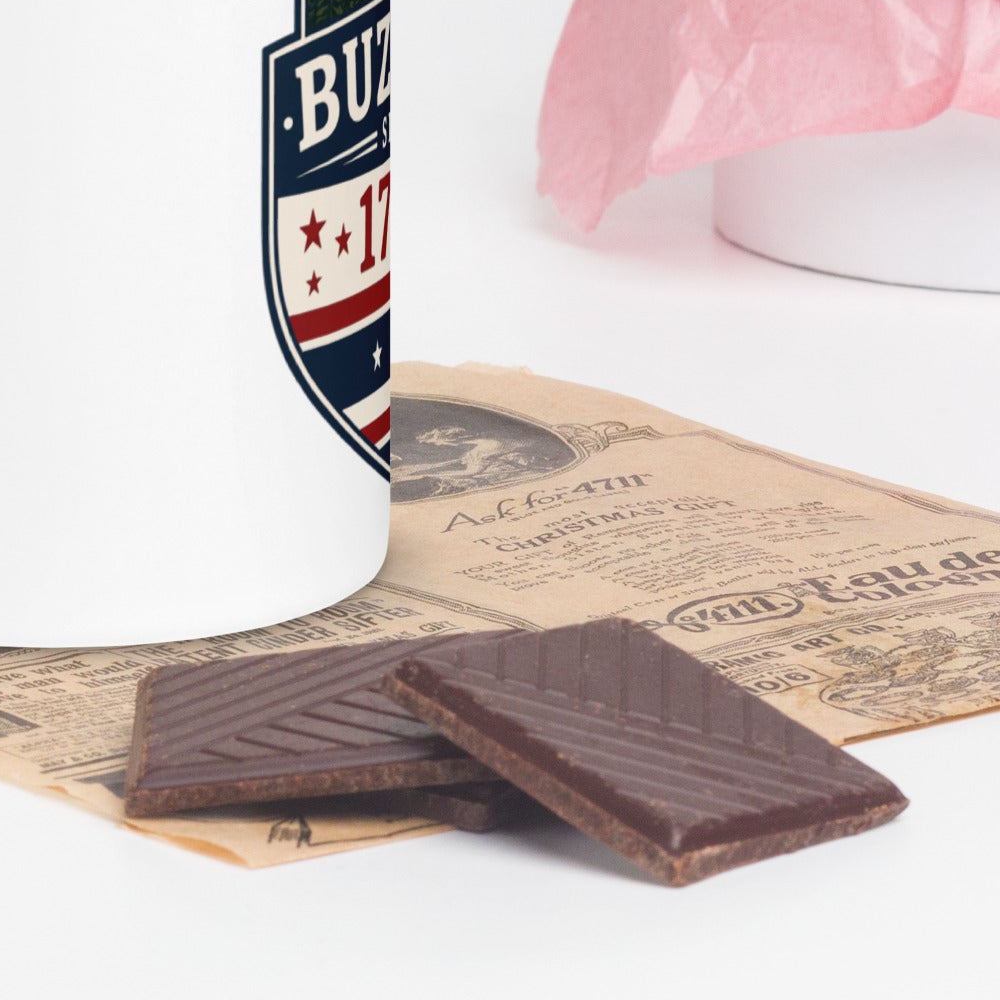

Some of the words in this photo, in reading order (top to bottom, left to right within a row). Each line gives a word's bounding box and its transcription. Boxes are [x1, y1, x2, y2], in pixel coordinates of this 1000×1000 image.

[441, 498, 515, 533] Ask
[523, 490, 568, 510] for
[472, 536, 520, 545] The
[543, 510, 588, 528] most
[496, 507, 665, 552] CHRISTMAS
[673, 500, 737, 512] GIFT
[453, 561, 508, 575] YOUR
[801, 560, 935, 593] Eau
[939, 550, 1000, 571] de
[246, 625, 338, 650] CINDER
[332, 607, 425, 632] SIFTER
[418, 620, 457, 633] GIFT
[791, 633, 845, 653] ART
[13, 677, 64, 690] man
[72, 659, 145, 679] would
[29, 659, 91, 676] what
